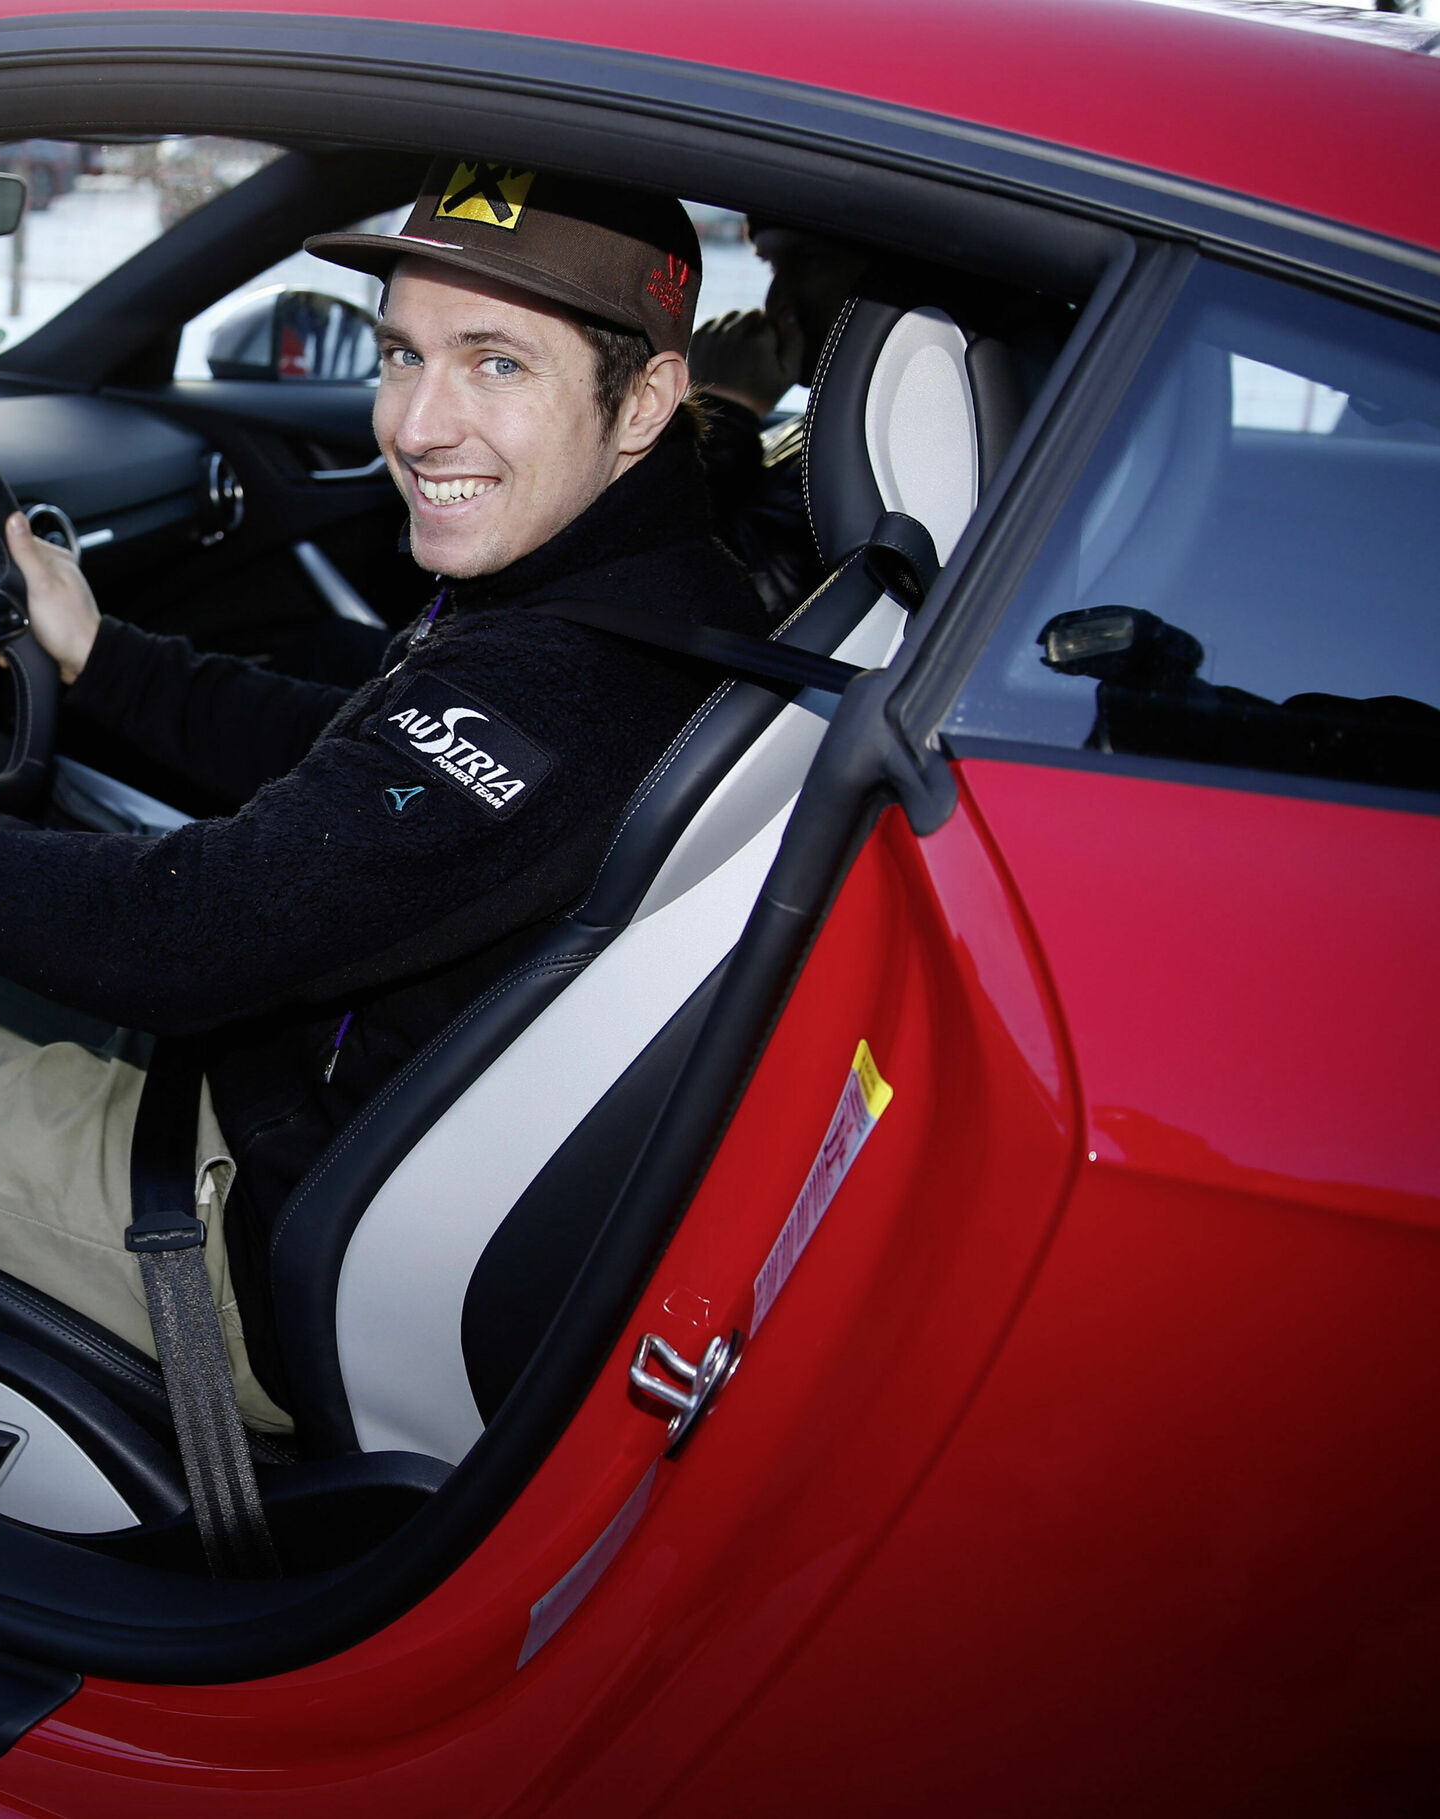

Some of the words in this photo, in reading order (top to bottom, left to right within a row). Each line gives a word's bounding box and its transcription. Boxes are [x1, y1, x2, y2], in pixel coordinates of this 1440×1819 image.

[387, 707, 527, 801] AUSTRIA
[432, 755, 472, 787] POWER
[470, 781, 505, 809] TEAM
